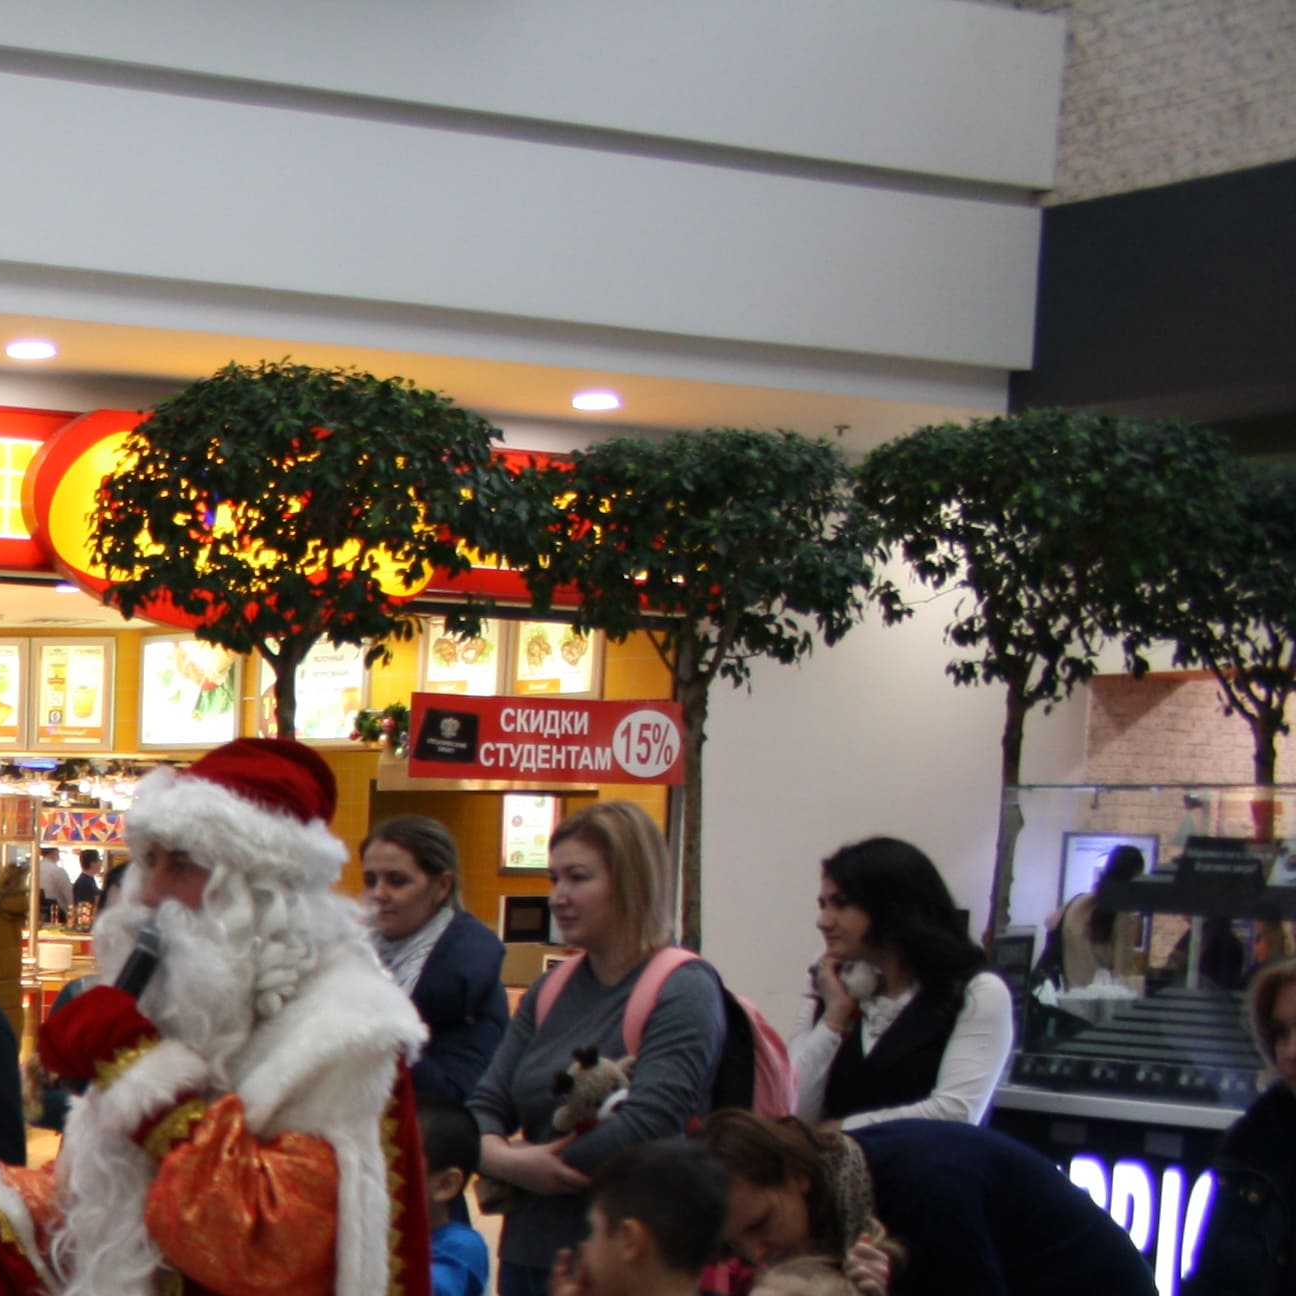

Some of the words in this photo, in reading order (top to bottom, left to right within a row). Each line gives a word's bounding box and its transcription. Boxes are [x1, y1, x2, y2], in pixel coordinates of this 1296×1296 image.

[499, 707, 589, 739] СКИДКИ
[479, 742, 613, 773] СТУДЕНТАМ
[620, 721, 673, 766] 15%
